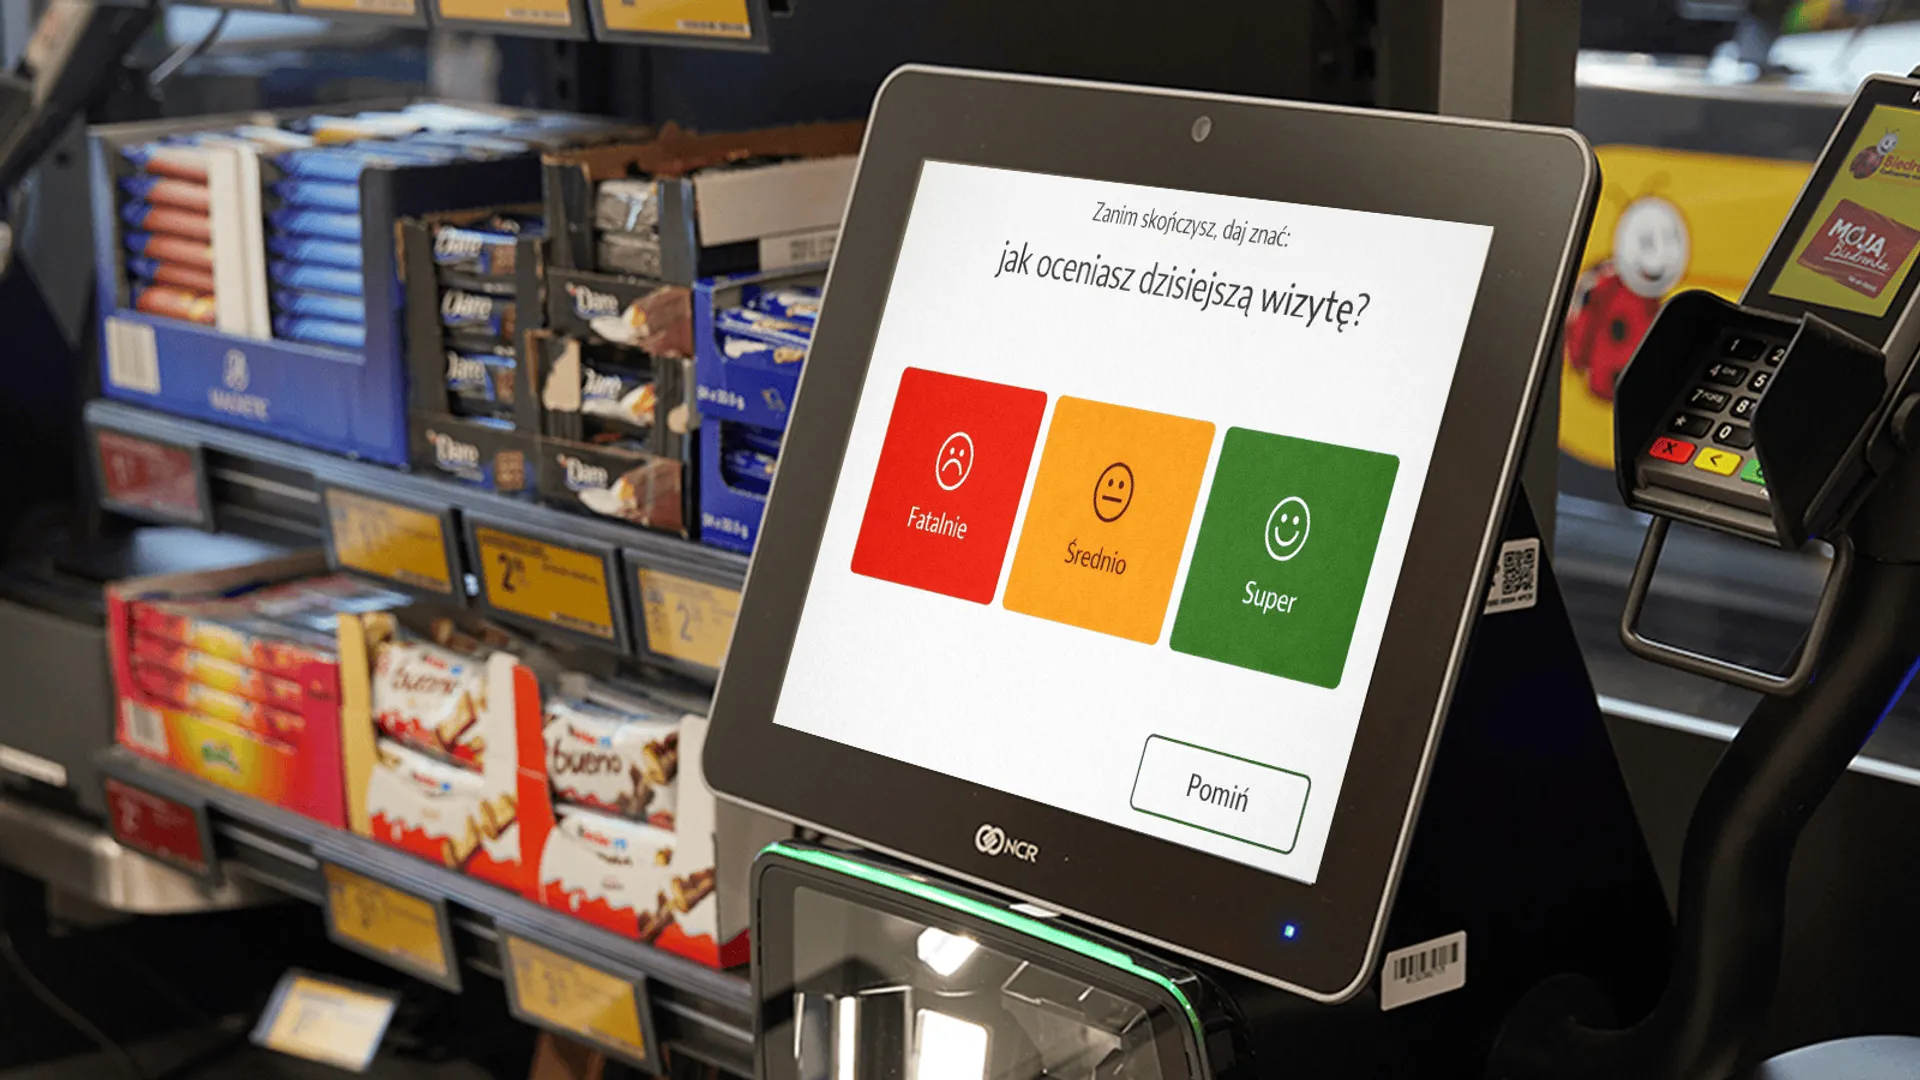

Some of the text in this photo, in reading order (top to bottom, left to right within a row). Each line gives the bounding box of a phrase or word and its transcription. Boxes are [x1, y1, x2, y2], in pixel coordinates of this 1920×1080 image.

[1092, 201, 1291, 248] Zanim skończysz, daj znać:
[576, 284, 620, 311] Dare
[994, 240, 1371, 333] jak oceniasz dzisiejszą wizytę?
[1730, 339, 1785, 361] 1 2
[1710, 364, 1721, 377] 4
[1754, 374, 1767, 388] 5
[1692, 389, 1703, 402] 7
[1736, 400, 1749, 413] 8
[1719, 426, 1732, 439] 0
[566, 457, 609, 485] Dare
[907, 505, 968, 540] Fatalnie
[1064, 538, 1127, 576] Średnio
[1242, 580, 1297, 615] Super
[552, 740, 623, 776] bueno
[1186, 773, 1249, 813] Pomiń
[1003, 837, 1040, 864] NCR
